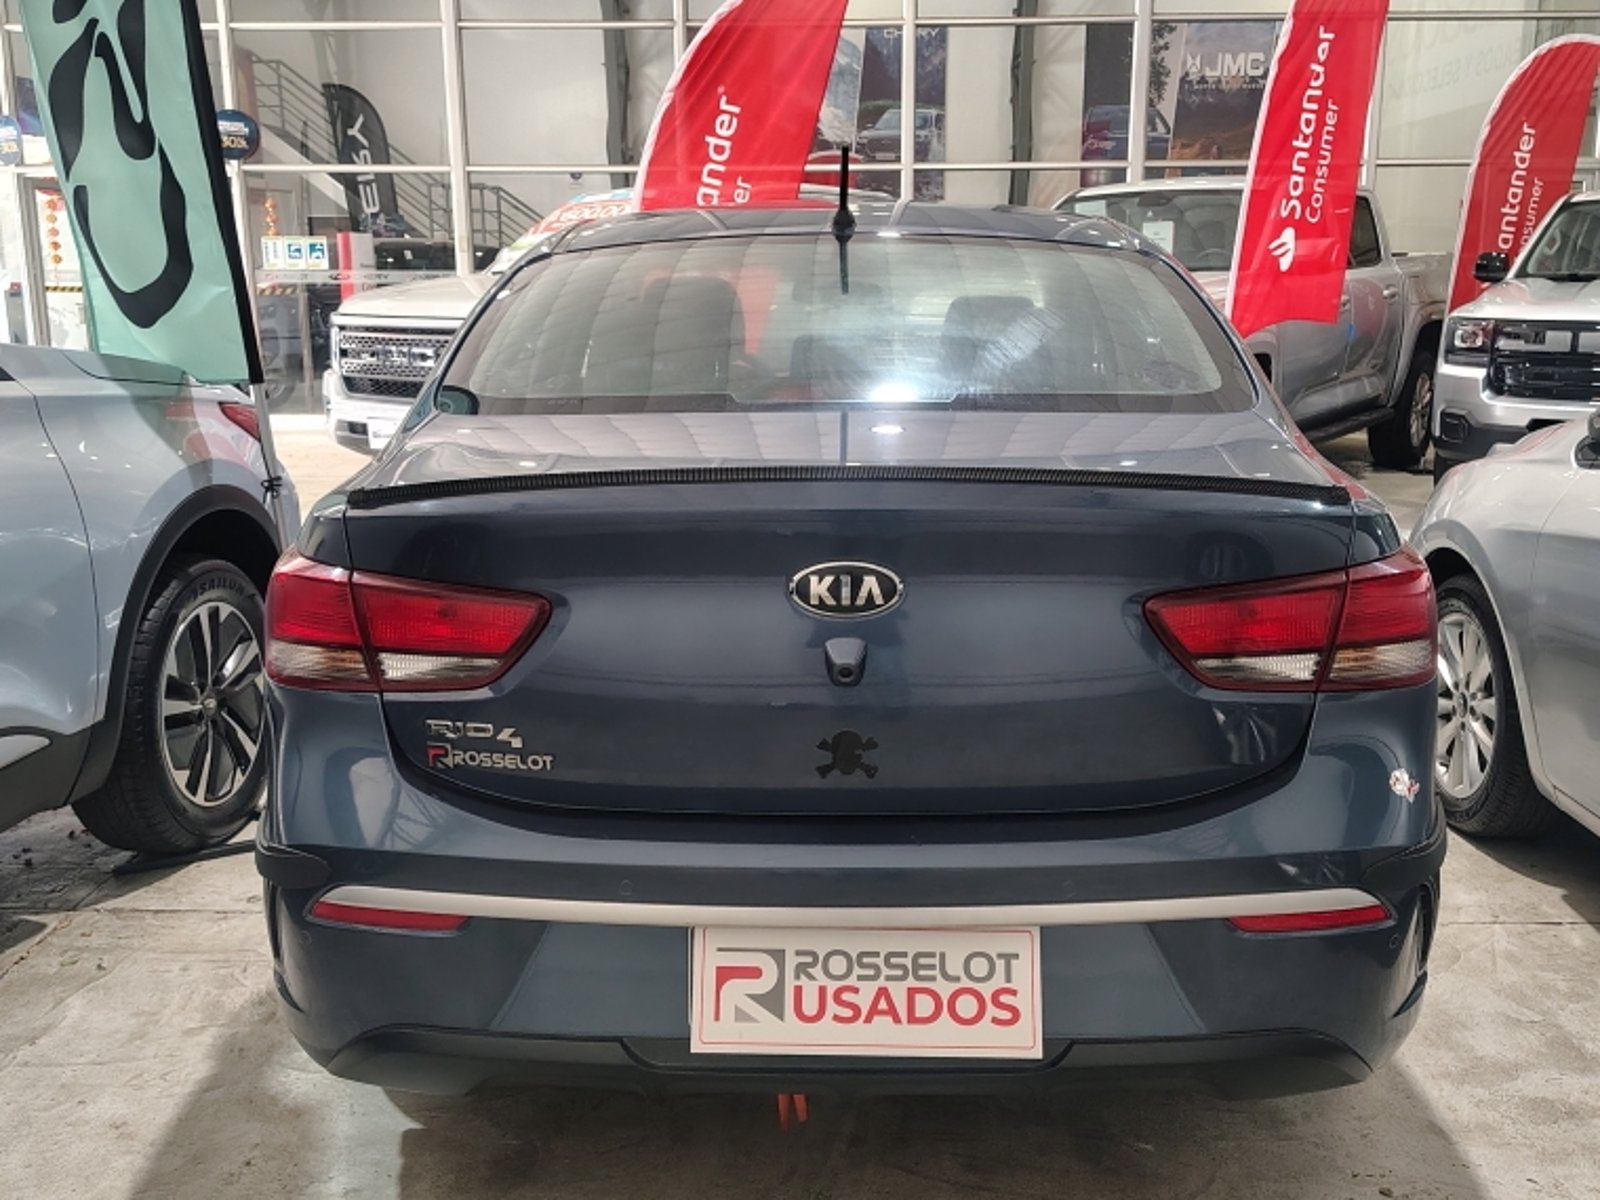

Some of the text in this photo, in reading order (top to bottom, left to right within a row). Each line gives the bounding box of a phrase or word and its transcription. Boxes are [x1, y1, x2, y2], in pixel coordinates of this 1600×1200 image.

[883, 27, 940, 38] CHRY
[1205, 52, 1265, 76] JMC
[696, 94, 741, 207] ander
[1305, 99, 1340, 223] Consumer
[1498, 122, 1536, 251] antander
[808, 574, 885, 605] KIA
[425, 719, 523, 749] RIO 4
[453, 750, 554, 772] ROSSELOT
[793, 949, 1020, 984] ROSSELOT
[792, 984, 1023, 1028] USADOS
